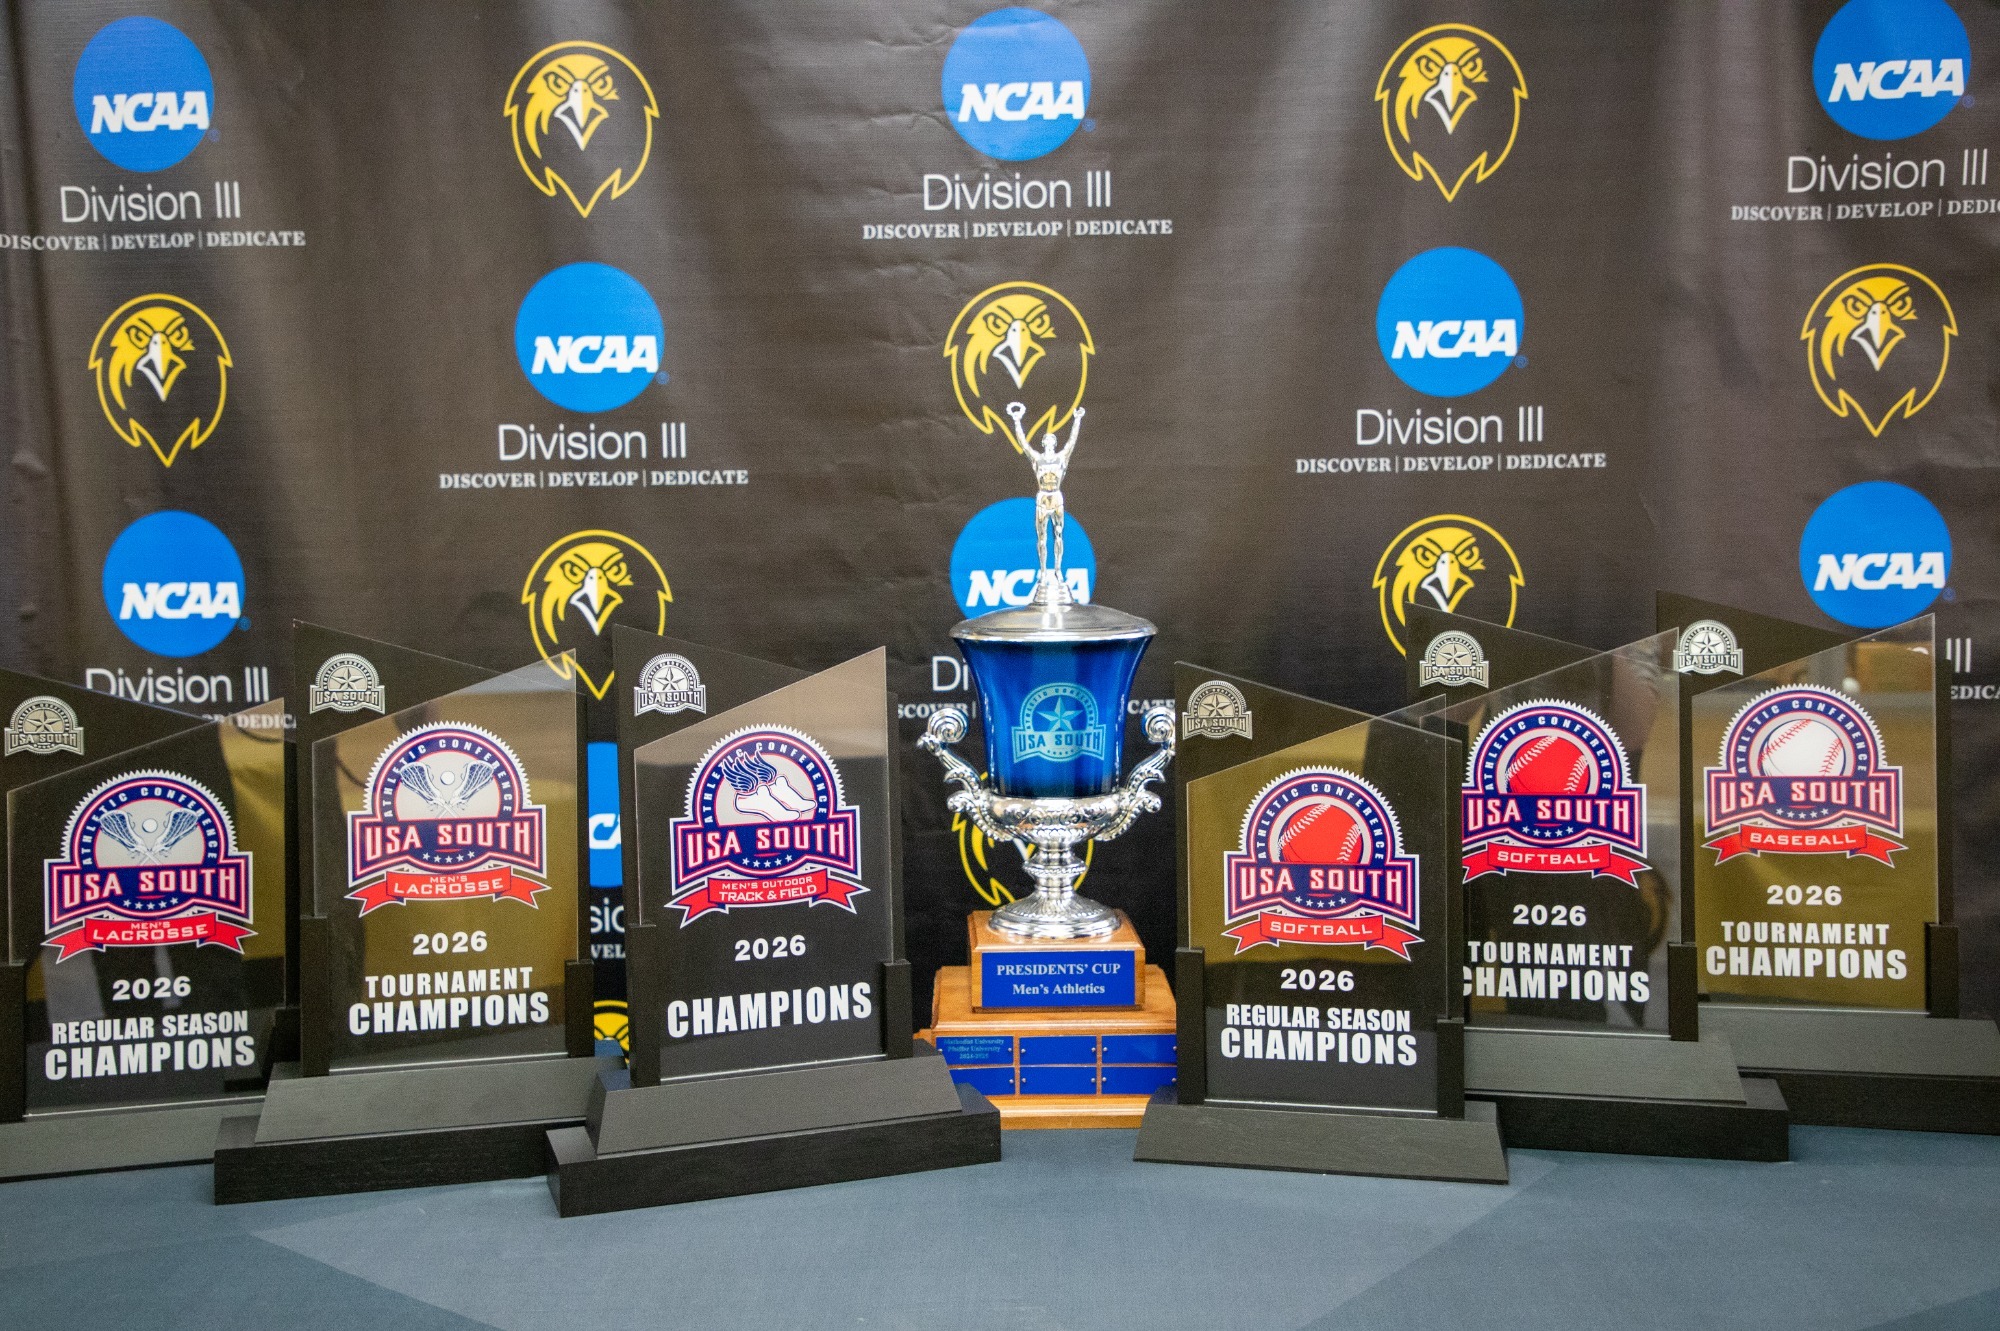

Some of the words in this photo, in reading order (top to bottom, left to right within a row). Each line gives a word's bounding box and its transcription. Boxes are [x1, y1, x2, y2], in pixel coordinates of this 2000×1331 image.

[1828, 58, 1964, 102] NCAA
[91, 90, 210, 133] NCAA
[958, 81, 1084, 122] NCAA
[1787, 152, 1945, 193] Division
[1962, 148, 1988, 186] III
[60, 184, 202, 223] Division
[215, 181, 241, 219] III
[922, 172, 1072, 212] Division
[1086, 170, 1111, 208] III
[1731, 205, 1823, 221] DISCOVER
[1836, 201, 1934, 220] DEVELOP
[0, 233, 100, 251] DISCOVER
[111, 231, 195, 250] DEVELOP
[206, 230, 306, 247] DEDICATE
[862, 223, 961, 240] DISCOVER
[972, 221, 1063, 238] DEVELOP
[1074, 219, 1173, 236] DEDICATE
[531, 335, 659, 374] NCAA
[1391, 319, 1517, 359] NCAA
[1357, 408, 1503, 445] Division
[1518, 405, 1543, 442] III
[498, 423, 647, 461] Division
[661, 422, 686, 458] III
[1296, 457, 1391, 474] DISCOVER
[1403, 455, 1493, 472] DEVELOP
[1506, 452, 1607, 470] DEDICATE
[439, 473, 536, 489] DISCOVER
[548, 471, 639, 487] DEVELOP
[651, 469, 749, 486] DEDICATE
[1813, 552, 1945, 592] NCAA
[119, 581, 241, 620] NCAA
[1425, 667, 1445, 680] USA
[1450, 666, 1483, 680] SOUTH
[1679, 655, 1698, 668] USA
[1704, 655, 1737, 669] SOUTH
[85, 666, 233, 704] Division
[244, 664, 270, 702] III
[317, 692, 338, 705] USA
[343, 691, 378, 705] SOUTH
[641, 693, 661, 707] USA
[667, 691, 700, 705] SOUTH
[12, 734, 34, 747] USA
[40, 734, 76, 747] SOUTH
[1188, 719, 1207, 731] USA
[1213, 718, 1246, 732] SOUTH
[1736, 704, 1780, 774] ATHLETIC
[1791, 699, 1868, 772] CONFERENCE
[1018, 733, 1046, 752] USA
[1054, 731, 1101, 750] SOUTH
[1484, 721, 1527, 791] ATHLETIC
[1537, 715, 1612, 791] CONFERENCE
[383, 744, 428, 818] ATHLETIC
[438, 739, 512, 813] CONFERENCE
[755, 742, 828, 815] CONFERENCE
[1719, 782, 1776, 815] USA
[1791, 781, 1887, 815] SOUTH
[82, 792, 128, 865] ATHLETIC
[140, 787, 218, 860] CONFERENCE
[1257, 787, 1299, 860] ATHLETIC
[1310, 783, 1385, 861] CONFERENCE
[1467, 799, 1522, 832] USA
[1537, 798, 1631, 835] SOUTH
[364, 825, 422, 862] USA
[437, 820, 531, 856] SOUTH
[686, 831, 741, 868] USA
[757, 822, 845, 861] SOUTH
[1749, 832, 1857, 847] BASEBALL
[1496, 850, 1601, 865] SOFTBALL
[62, 872, 124, 909] USA
[139, 867, 237, 903] SOUTH
[394, 878, 504, 895] LACROSSE
[430, 875, 468, 884] MEN'S
[719, 889, 765, 903] TRACK
[767, 889, 777, 899] &
[779, 885, 818, 899] FIELD
[721, 882, 760, 891] MEN'S
[762, 876, 814, 889] OUTDOOR
[1240, 866, 1294, 900] USA
[1310, 868, 1403, 905] SOUTH
[1766, 885, 1843, 906] 2026
[131, 920, 171, 930] MEN'S
[1269, 921, 1374, 938] SOFTBALL
[1512, 904, 1588, 927] 2026
[93, 923, 209, 942] LACROSSE
[412, 931, 488, 956] 2026
[734, 934, 807, 962] 2026
[1721, 921, 1890, 945] TOURNAMENT
[1091, 963, 1121, 975] CUP
[1468, 941, 1633, 968] TOURNAMENT
[1705, 945, 1908, 981] CHAMPIONS
[111, 976, 192, 1001] 2026
[365, 967, 534, 999] TOURNAMENT
[1013, 983, 1049, 995] Men's
[1053, 982, 1106, 995] Athletics
[1279, 968, 1355, 993] 2026
[349, 991, 550, 1036] CHAMPIONS
[667, 982, 873, 1039] CHAMPIONS
[1226, 1003, 1320, 1030] REGULAR
[1326, 1008, 1411, 1033] SEASON
[52, 1016, 155, 1045] REGULAR
[161, 1010, 249, 1036] SEASON
[44, 1035, 256, 1081] CHAMPIONS
[1221, 1027, 1418, 1067] CHAMPIONS
